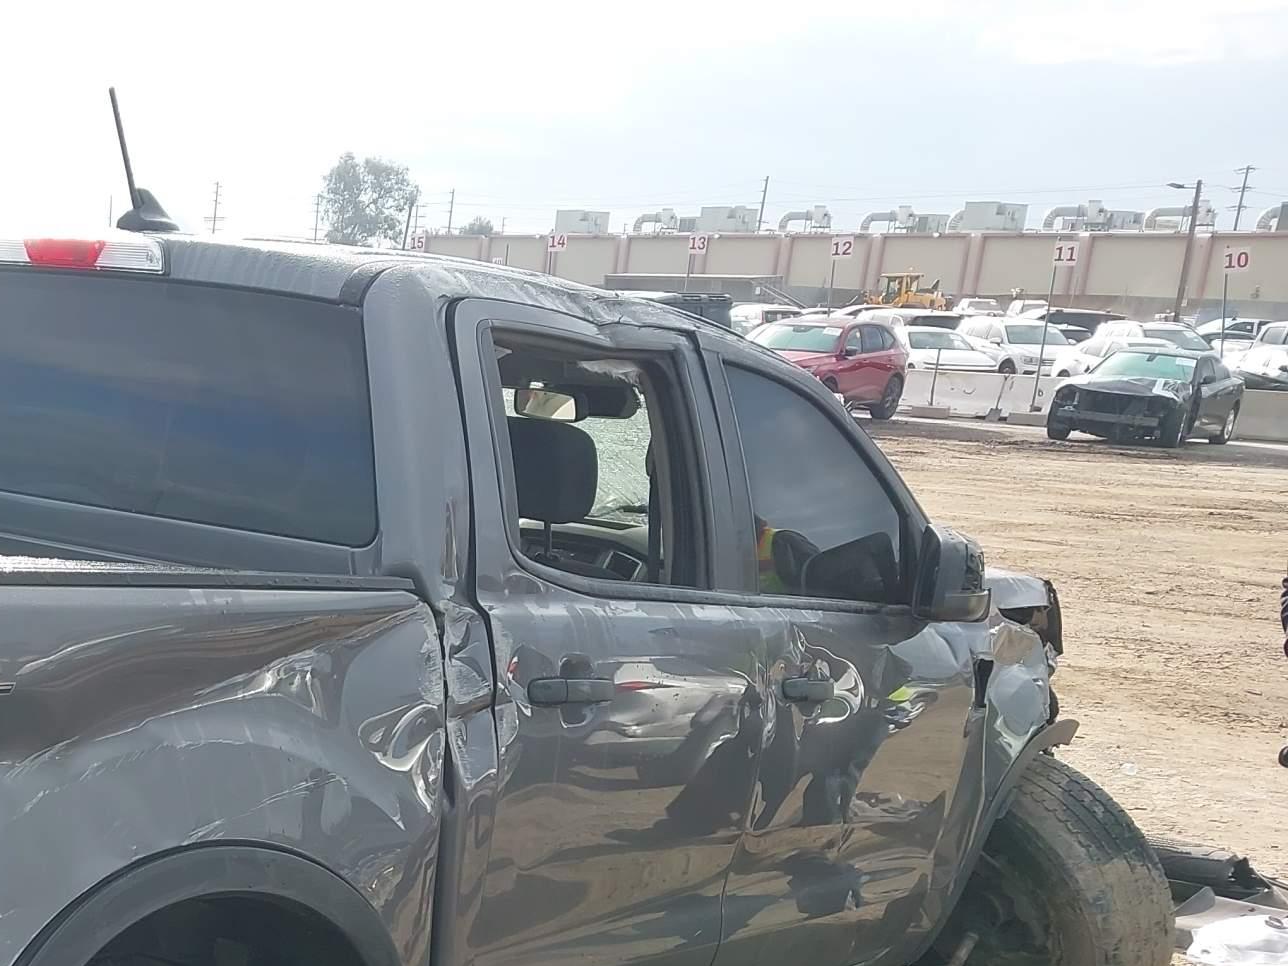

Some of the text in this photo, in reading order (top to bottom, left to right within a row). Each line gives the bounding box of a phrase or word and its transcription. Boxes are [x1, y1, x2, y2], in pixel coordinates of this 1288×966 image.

[410, 236, 425, 250] 15
[549, 235, 566, 249] 14
[689, 236, 707, 250] 13
[831, 240, 852, 257] 12
[1053, 246, 1076, 262] 11
[1224, 251, 1249, 269] 10
